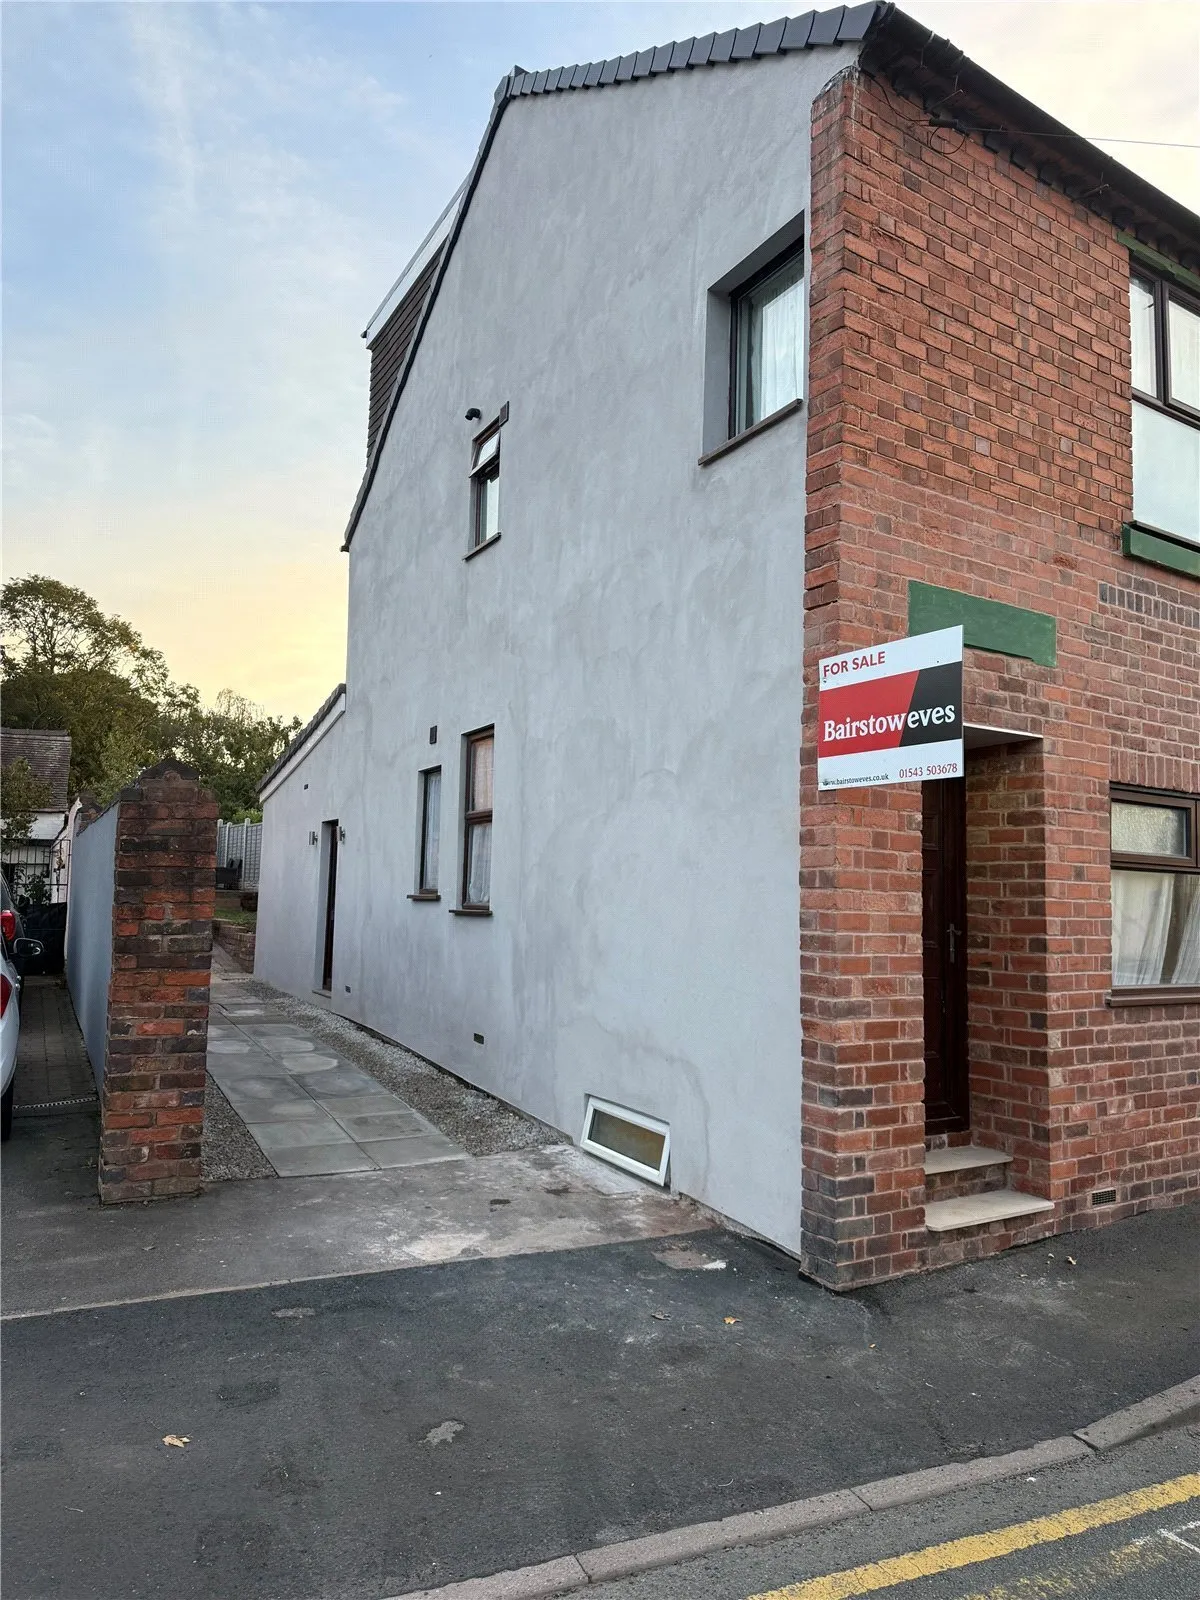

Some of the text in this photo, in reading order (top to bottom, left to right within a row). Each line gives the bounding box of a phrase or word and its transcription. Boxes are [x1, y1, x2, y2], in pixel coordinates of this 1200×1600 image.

[823, 651, 886, 678] FOR SALE
[823, 704, 956, 742] Bairstoweves
[899, 763, 958, 779] 01543 503678
